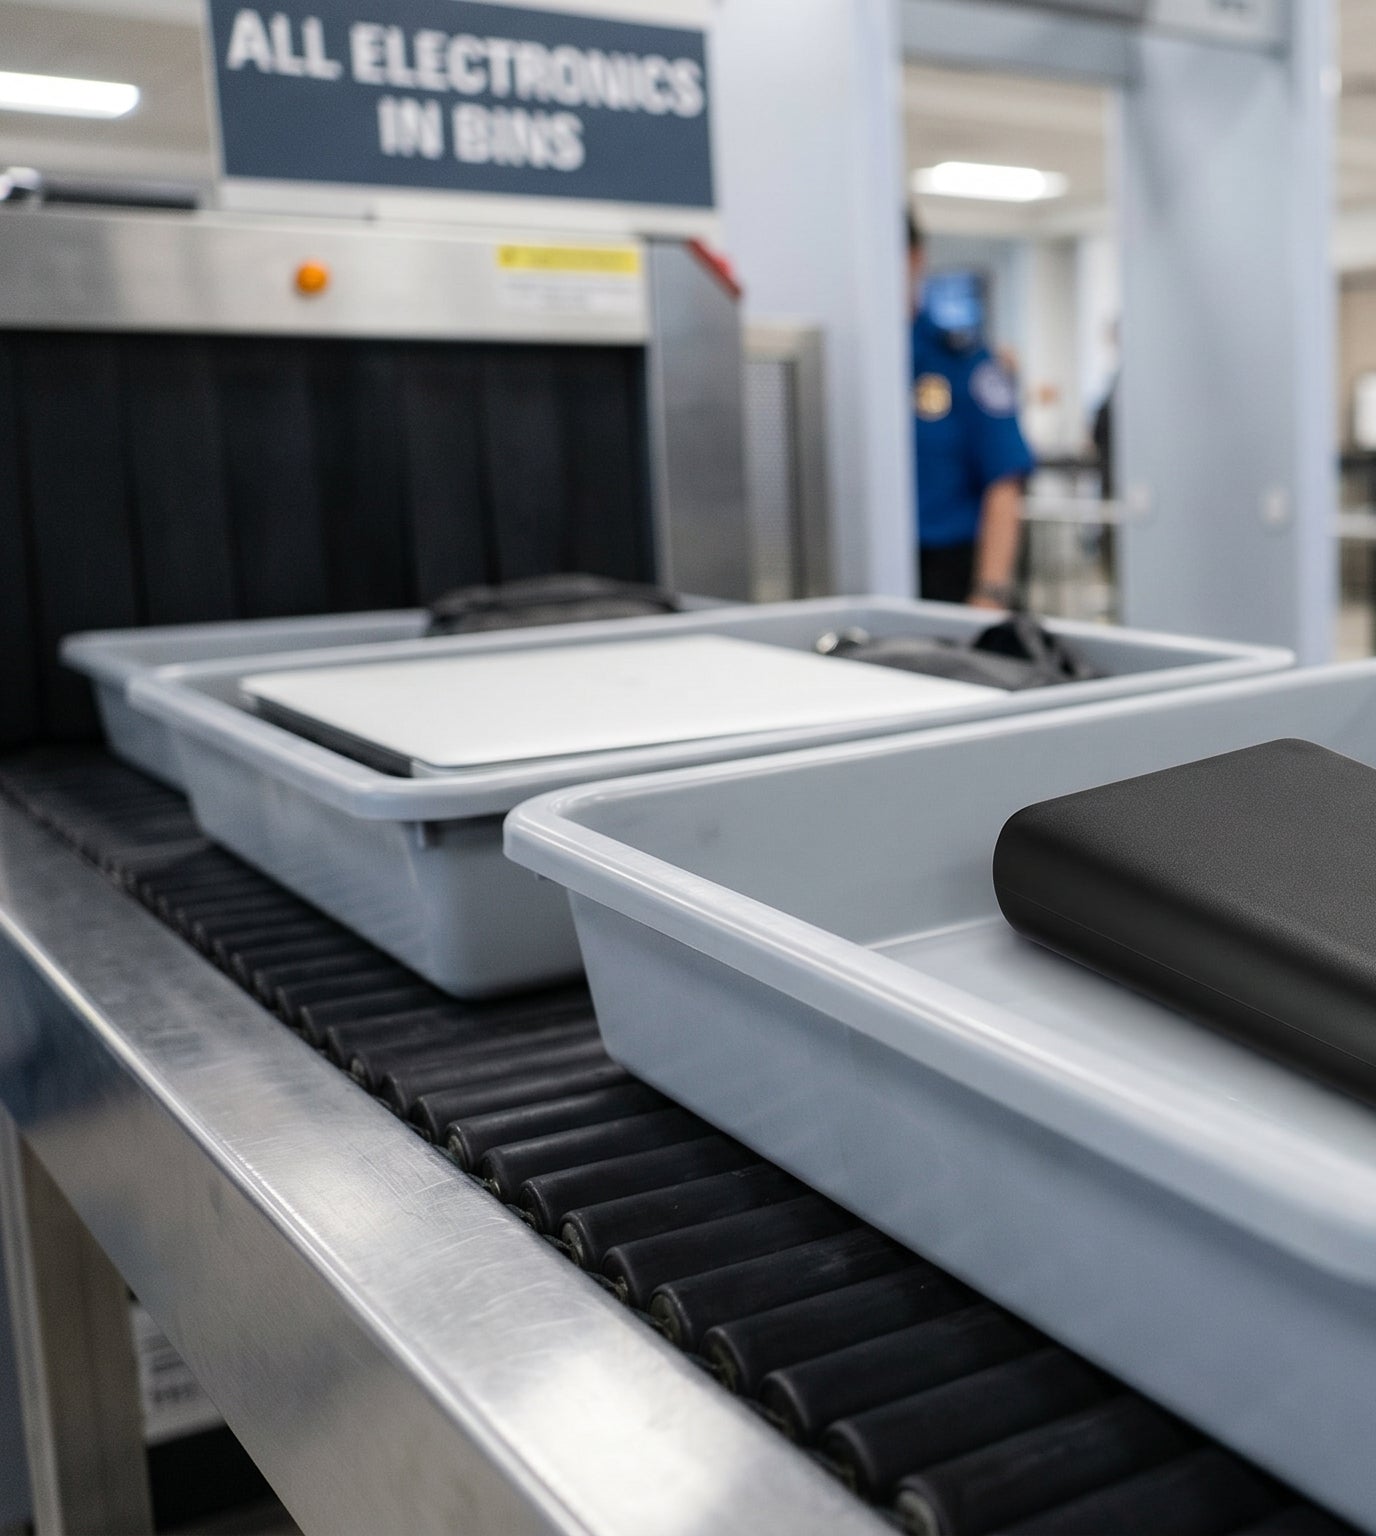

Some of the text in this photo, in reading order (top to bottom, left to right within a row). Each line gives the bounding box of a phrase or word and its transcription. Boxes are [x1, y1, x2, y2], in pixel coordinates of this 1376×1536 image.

[227, 8, 704, 118] ALL ELECTRONICS
[377, 95, 585, 172] IN BINS
